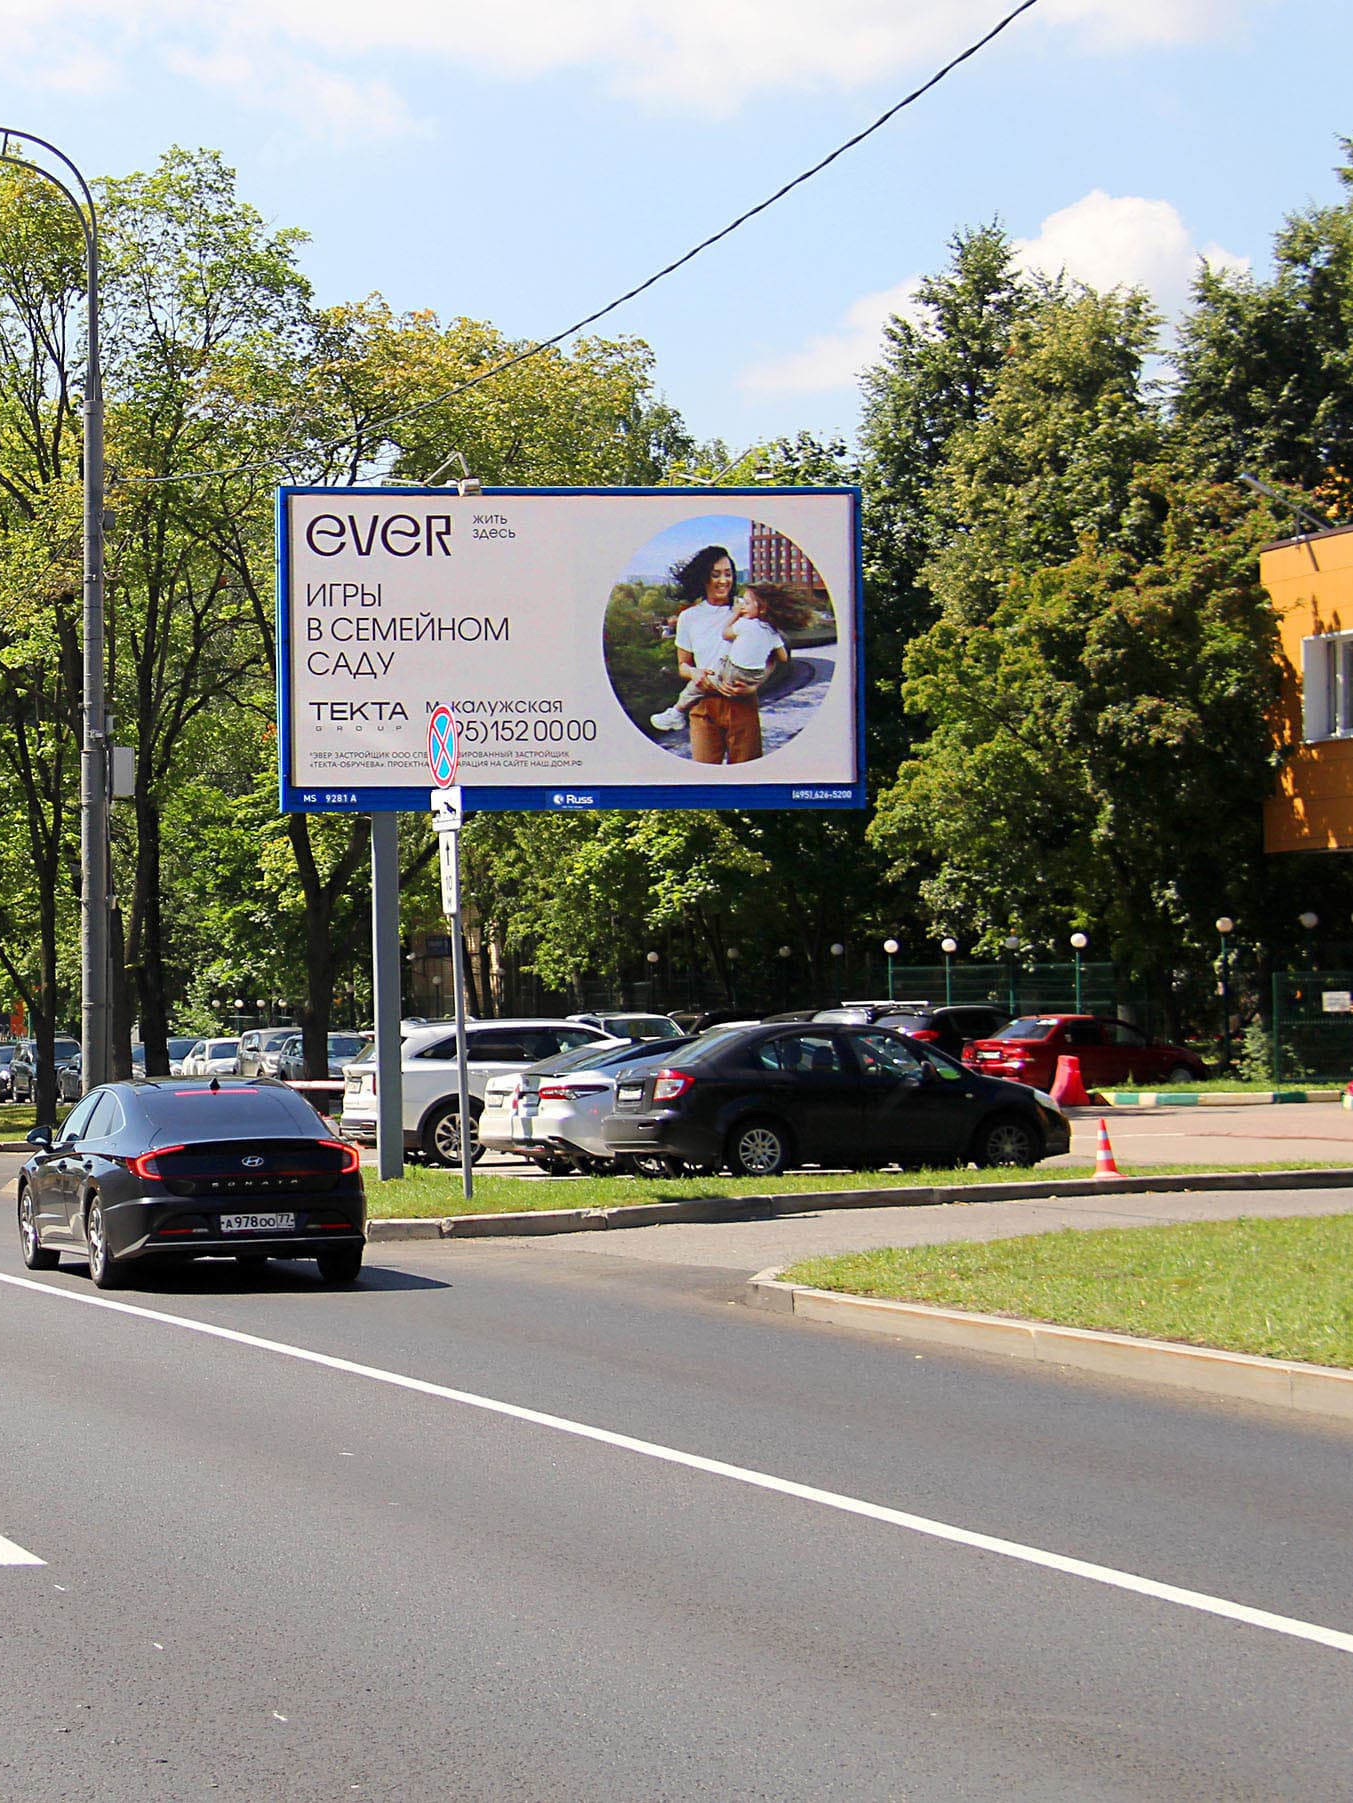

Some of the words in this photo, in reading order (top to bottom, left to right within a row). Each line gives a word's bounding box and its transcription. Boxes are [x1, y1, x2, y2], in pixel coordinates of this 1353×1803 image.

[473, 514, 508, 525] жить
[473, 528, 516, 540] здесь
[307, 583, 382, 607] ИГРЫ
[307, 617, 323, 642] В
[331, 612, 509, 642] СЕМЕЙНОМ
[307, 651, 395, 680] САДУ
[452, 700, 563, 717] калужская
[335, 750, 389, 760] ЗАСТРОЙЩИК
[391, 751, 411, 759] ООО
[515, 750, 569, 760] ЗАСТРОЙЩИК
[387, 760, 430, 768] ПРОЕКТНА
[490, 759, 502, 767] НА
[503, 758, 529, 767] САЙТЕ
[303, 794, 317, 802] MS
[325, 794, 348, 803] 9281
[566, 794, 594, 804] Russ
[278, 1214, 291, 1223] 77
